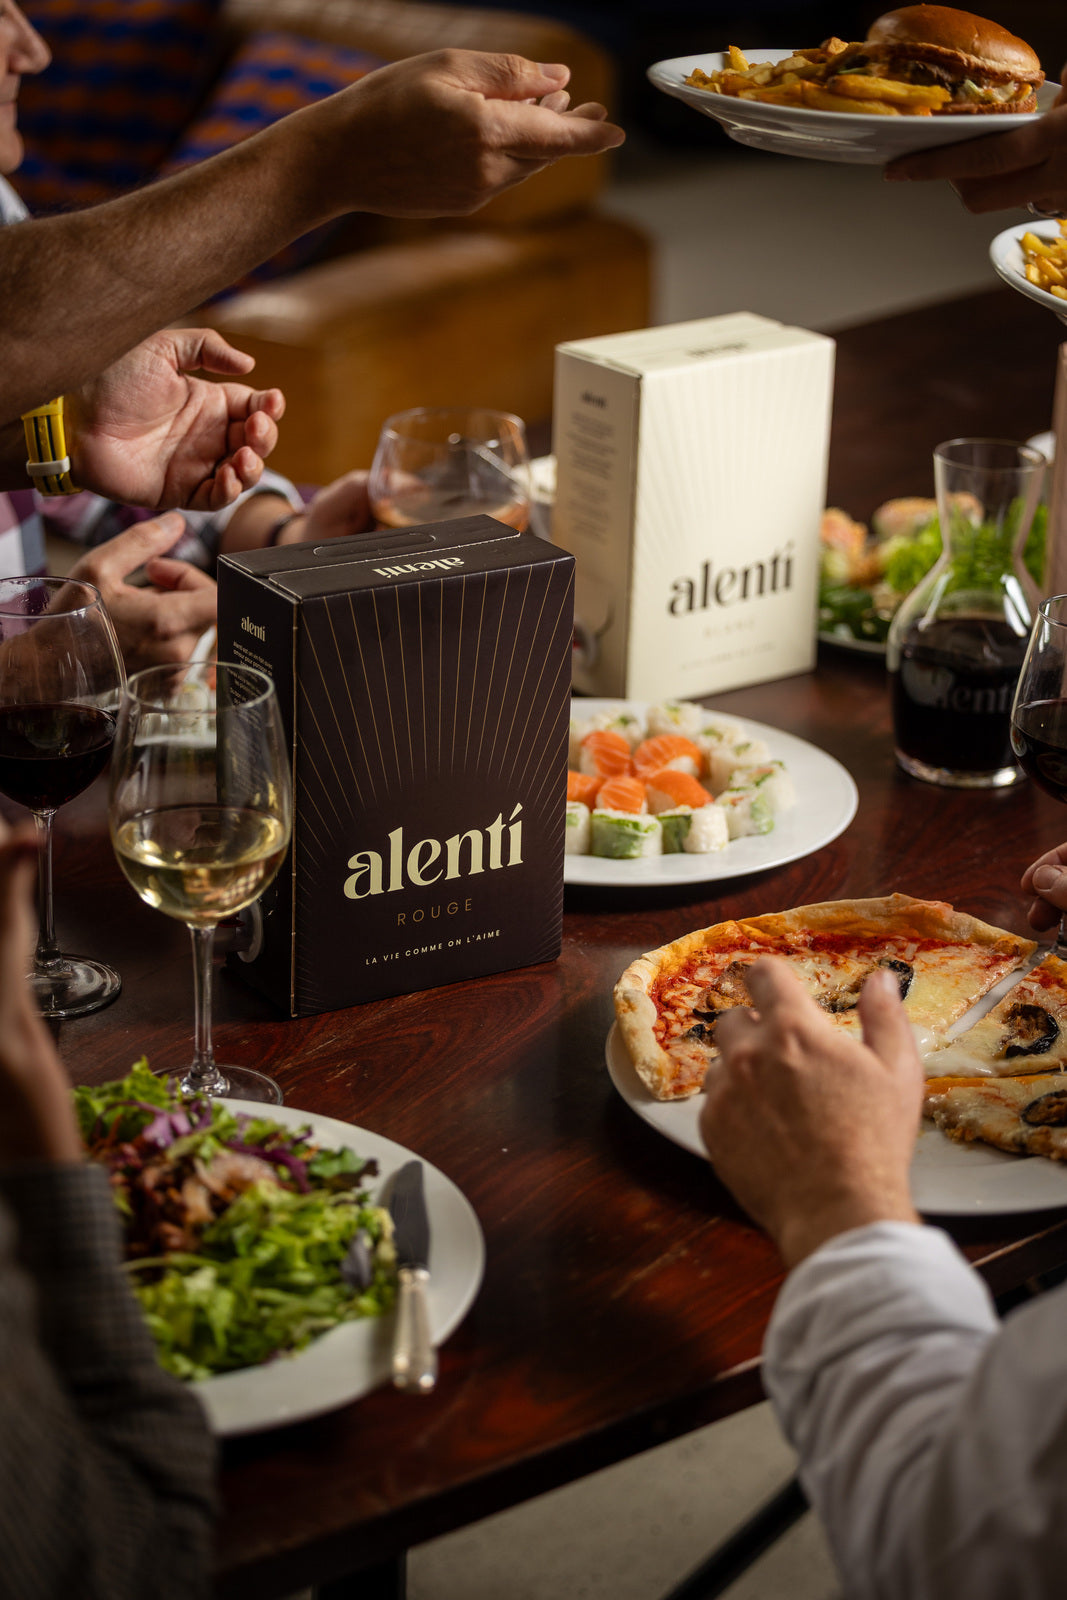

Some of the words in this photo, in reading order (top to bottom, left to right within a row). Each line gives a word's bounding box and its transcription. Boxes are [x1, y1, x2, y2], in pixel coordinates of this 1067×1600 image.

[343, 802, 523, 899] alentí
[397, 898, 473, 926] ROUGE
[365, 956, 377, 965] LA
[383, 952, 400, 962] VIE
[405, 943, 443, 957] COMME
[447, 939, 462, 947] ON
[466, 930, 501, 943] L'AIME
